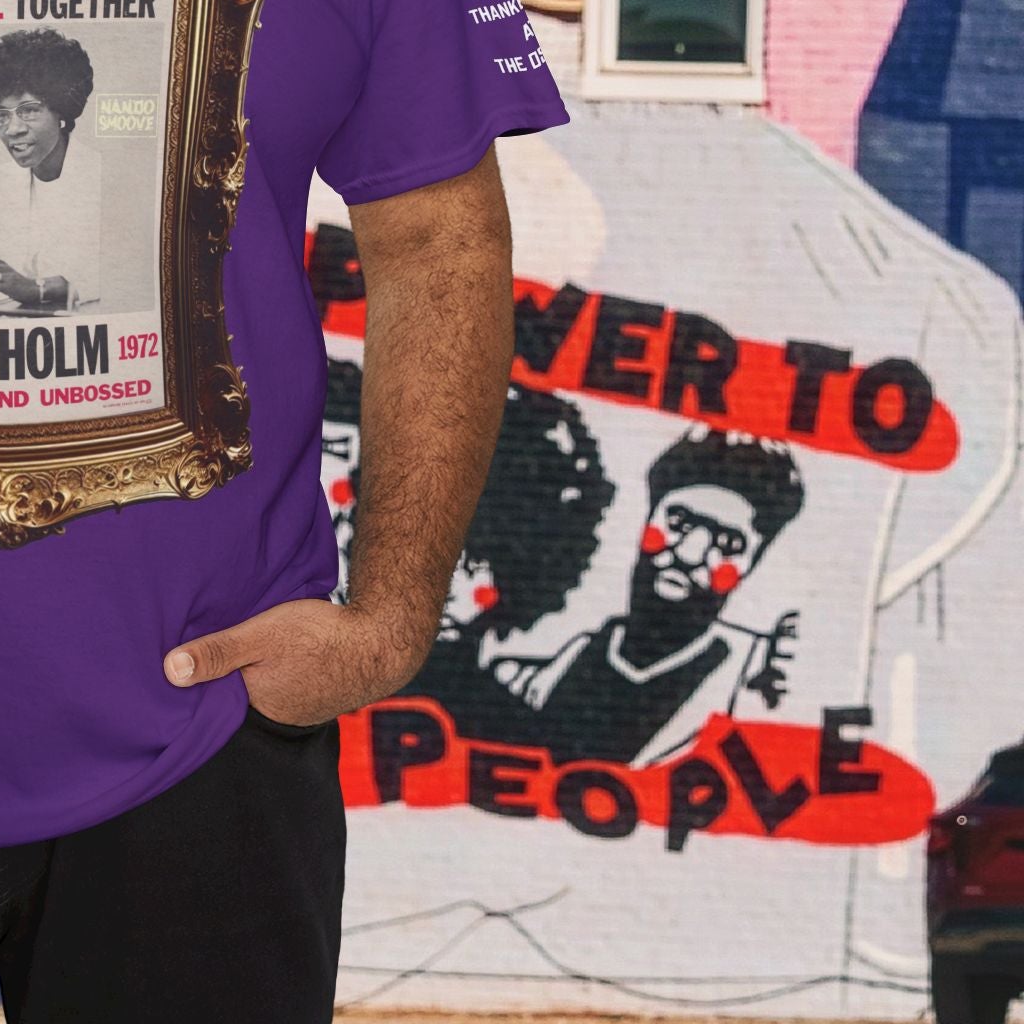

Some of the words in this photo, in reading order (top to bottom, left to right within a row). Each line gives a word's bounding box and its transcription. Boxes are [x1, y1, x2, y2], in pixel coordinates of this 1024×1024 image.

[493, 56, 527, 74] THE
[117, 332, 159, 361] 1972
[310, 223, 738, 415] PWER
[783, 339, 935, 454] TO
[40, 379, 152, 407] UNBOSSED
[367, 706, 881, 852] PEOPLE
